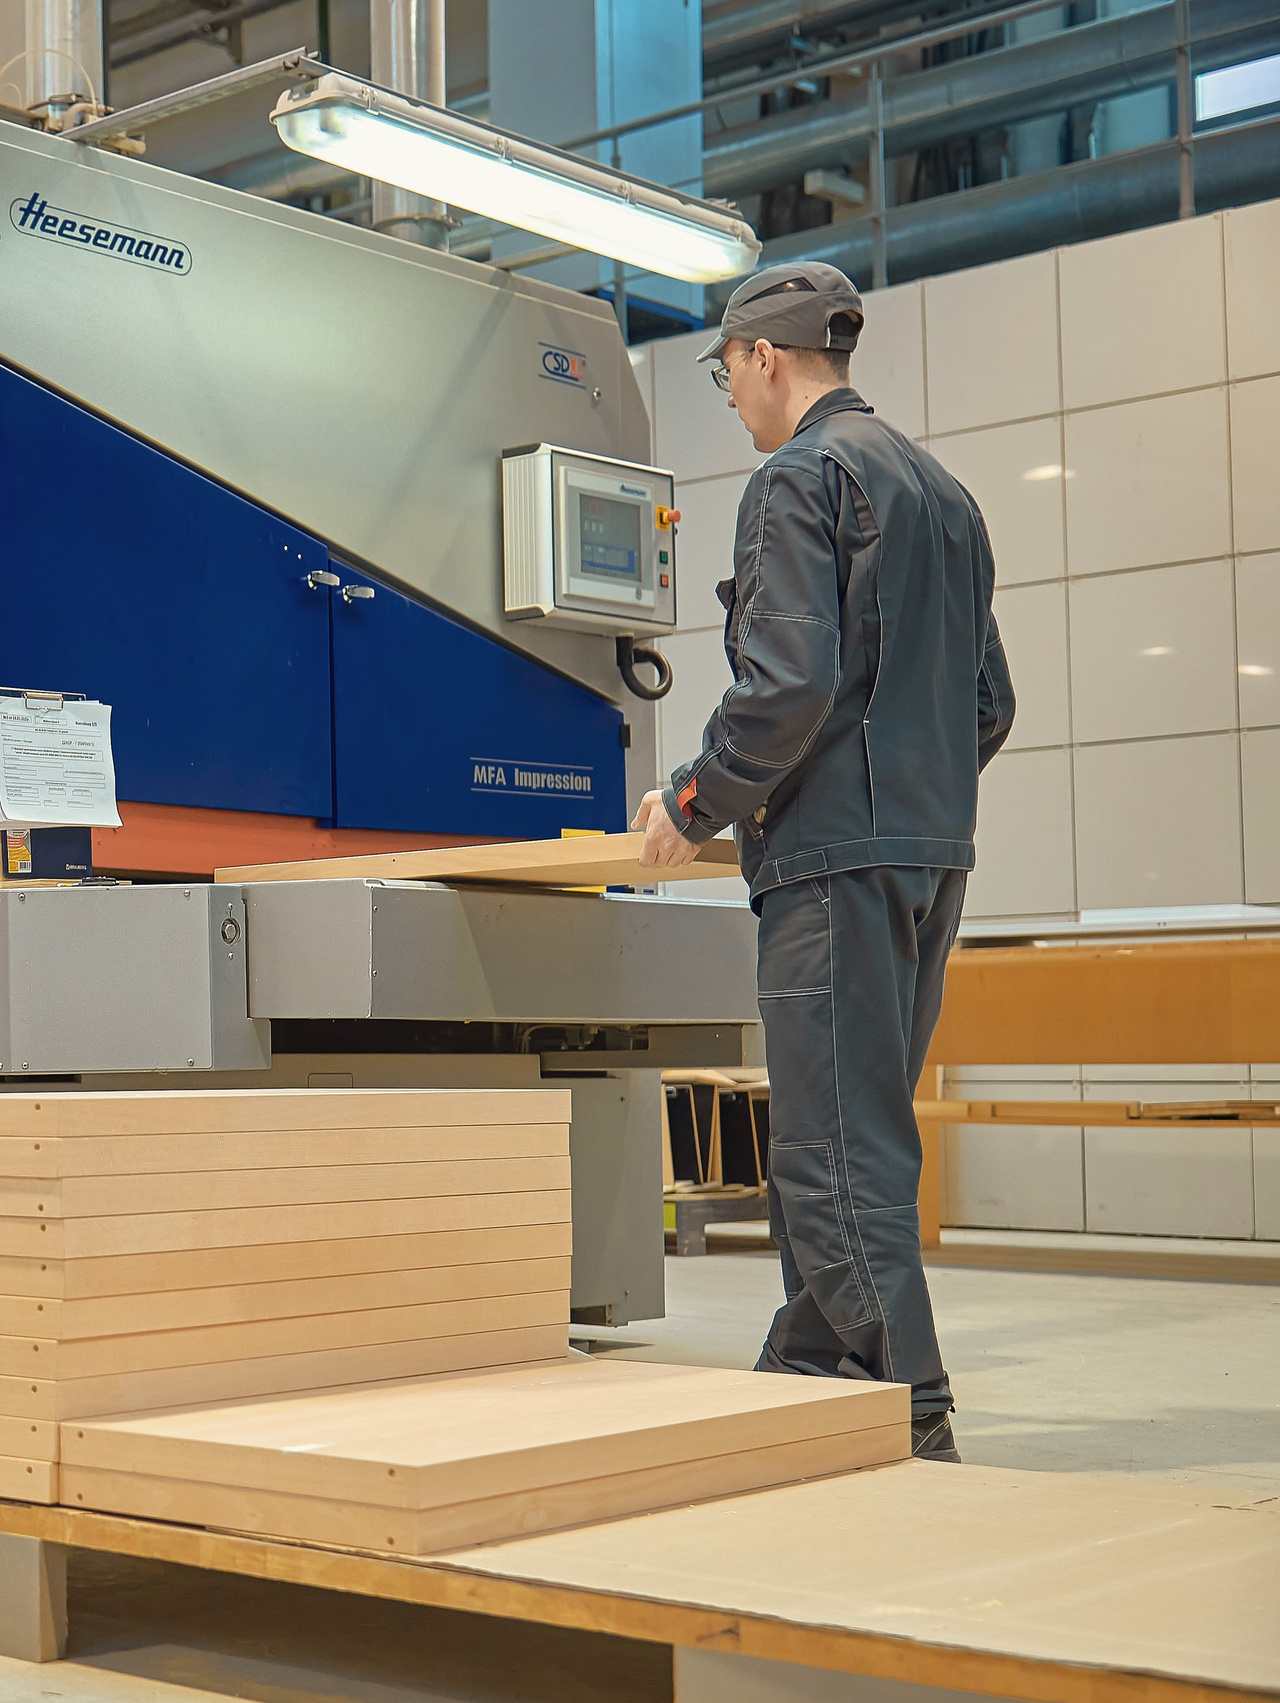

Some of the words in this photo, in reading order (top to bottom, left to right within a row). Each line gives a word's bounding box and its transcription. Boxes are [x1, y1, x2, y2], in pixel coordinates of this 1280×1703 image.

[19, 192, 184, 269] Heesemann
[473, 764, 507, 786] MFA
[514, 767, 591, 791] Impression
